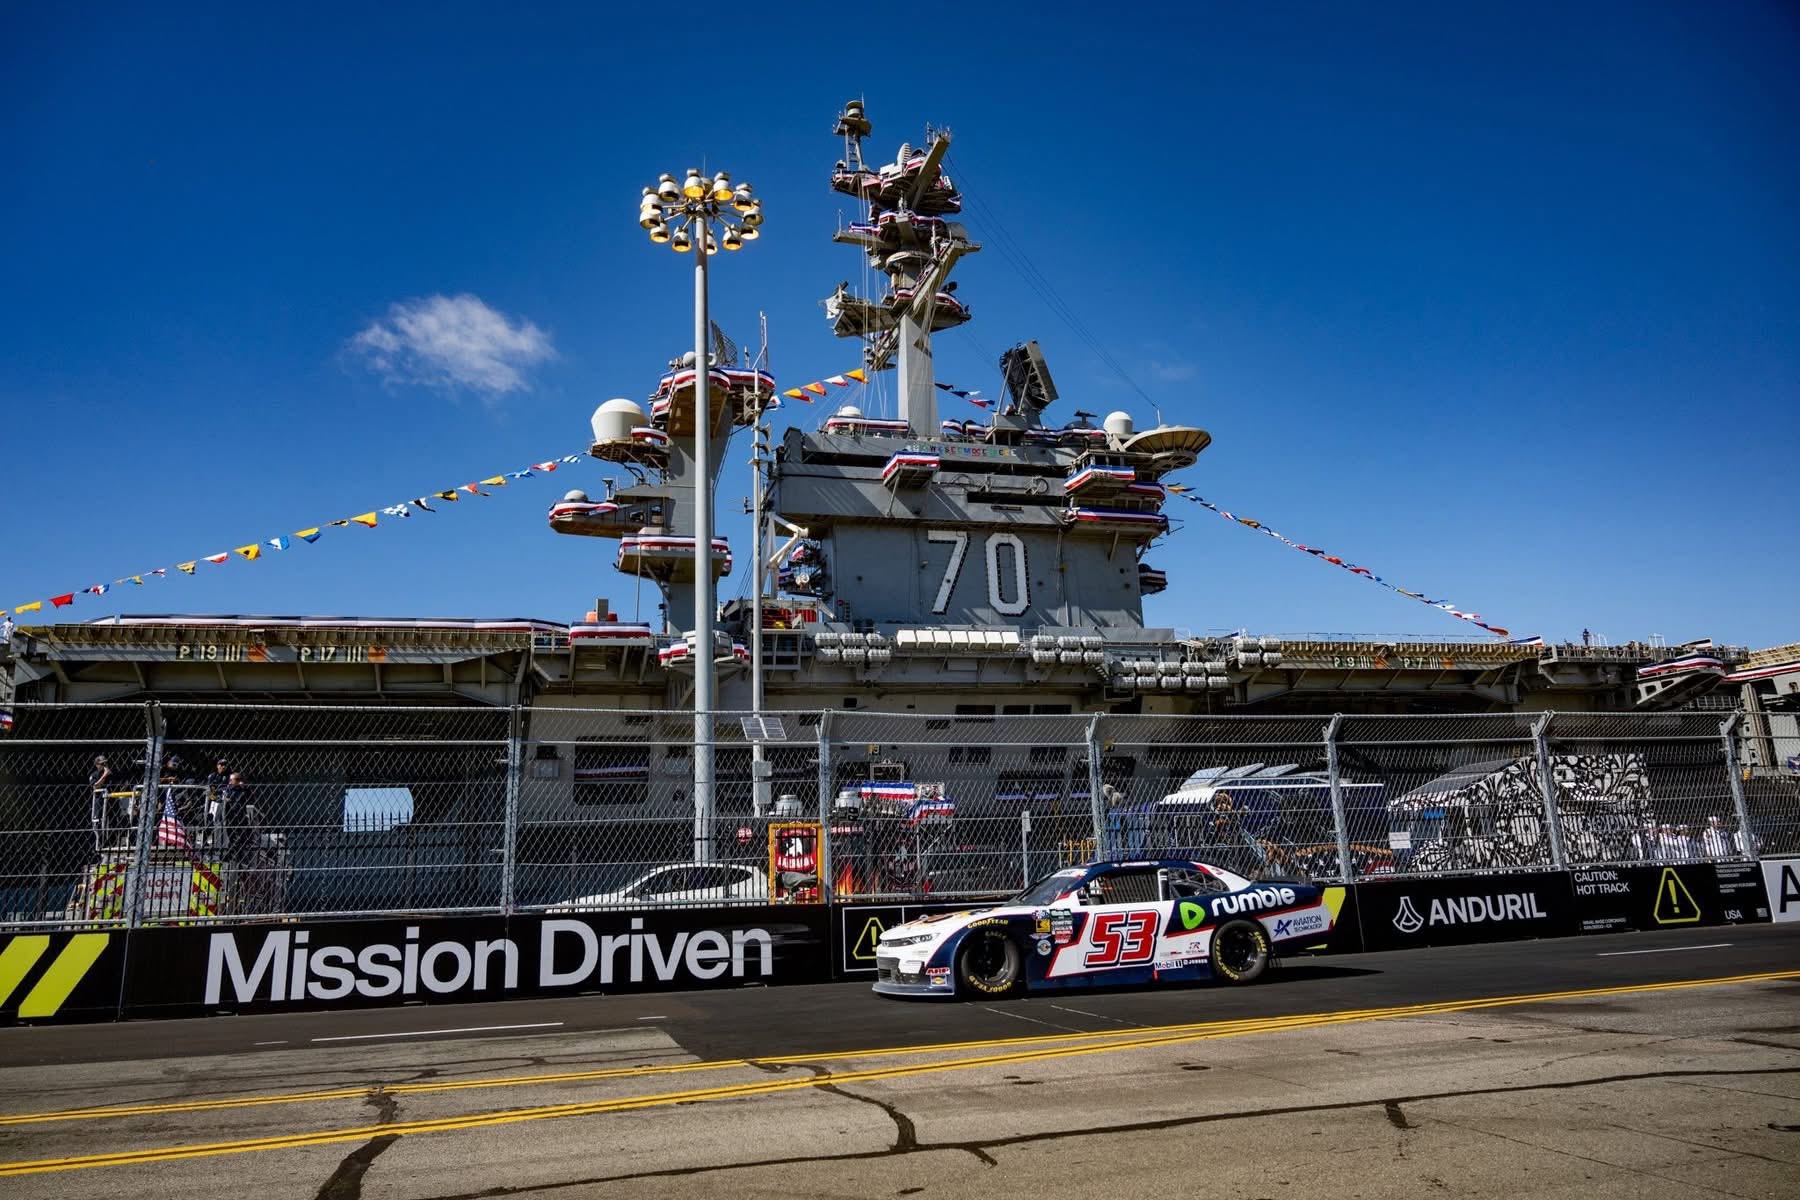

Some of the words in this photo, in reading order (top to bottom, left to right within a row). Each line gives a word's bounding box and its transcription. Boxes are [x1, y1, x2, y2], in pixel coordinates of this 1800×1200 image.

[927, 529, 1031, 617] 70
[179, 645, 190, 659] P
[200, 645, 217, 660] 19
[320, 646, 335, 661] 17
[1574, 870, 1618, 882] CAUTION:
[1576, 883, 1596, 895] HOT
[1597, 882, 1630, 894] TRACK
[1212, 886, 1296, 916] rumble
[1429, 891, 1547, 926] ANDURIL
[1293, 915, 1322, 927] AVIATION
[1724, 910, 1743, 920] USA
[967, 917, 1009, 929] GOODYEAR
[1083, 909, 1161, 968] 53
[204, 926, 519, 1005] Mission
[539, 917, 773, 988] Driven
[1155, 961, 1175, 970] Mobil
